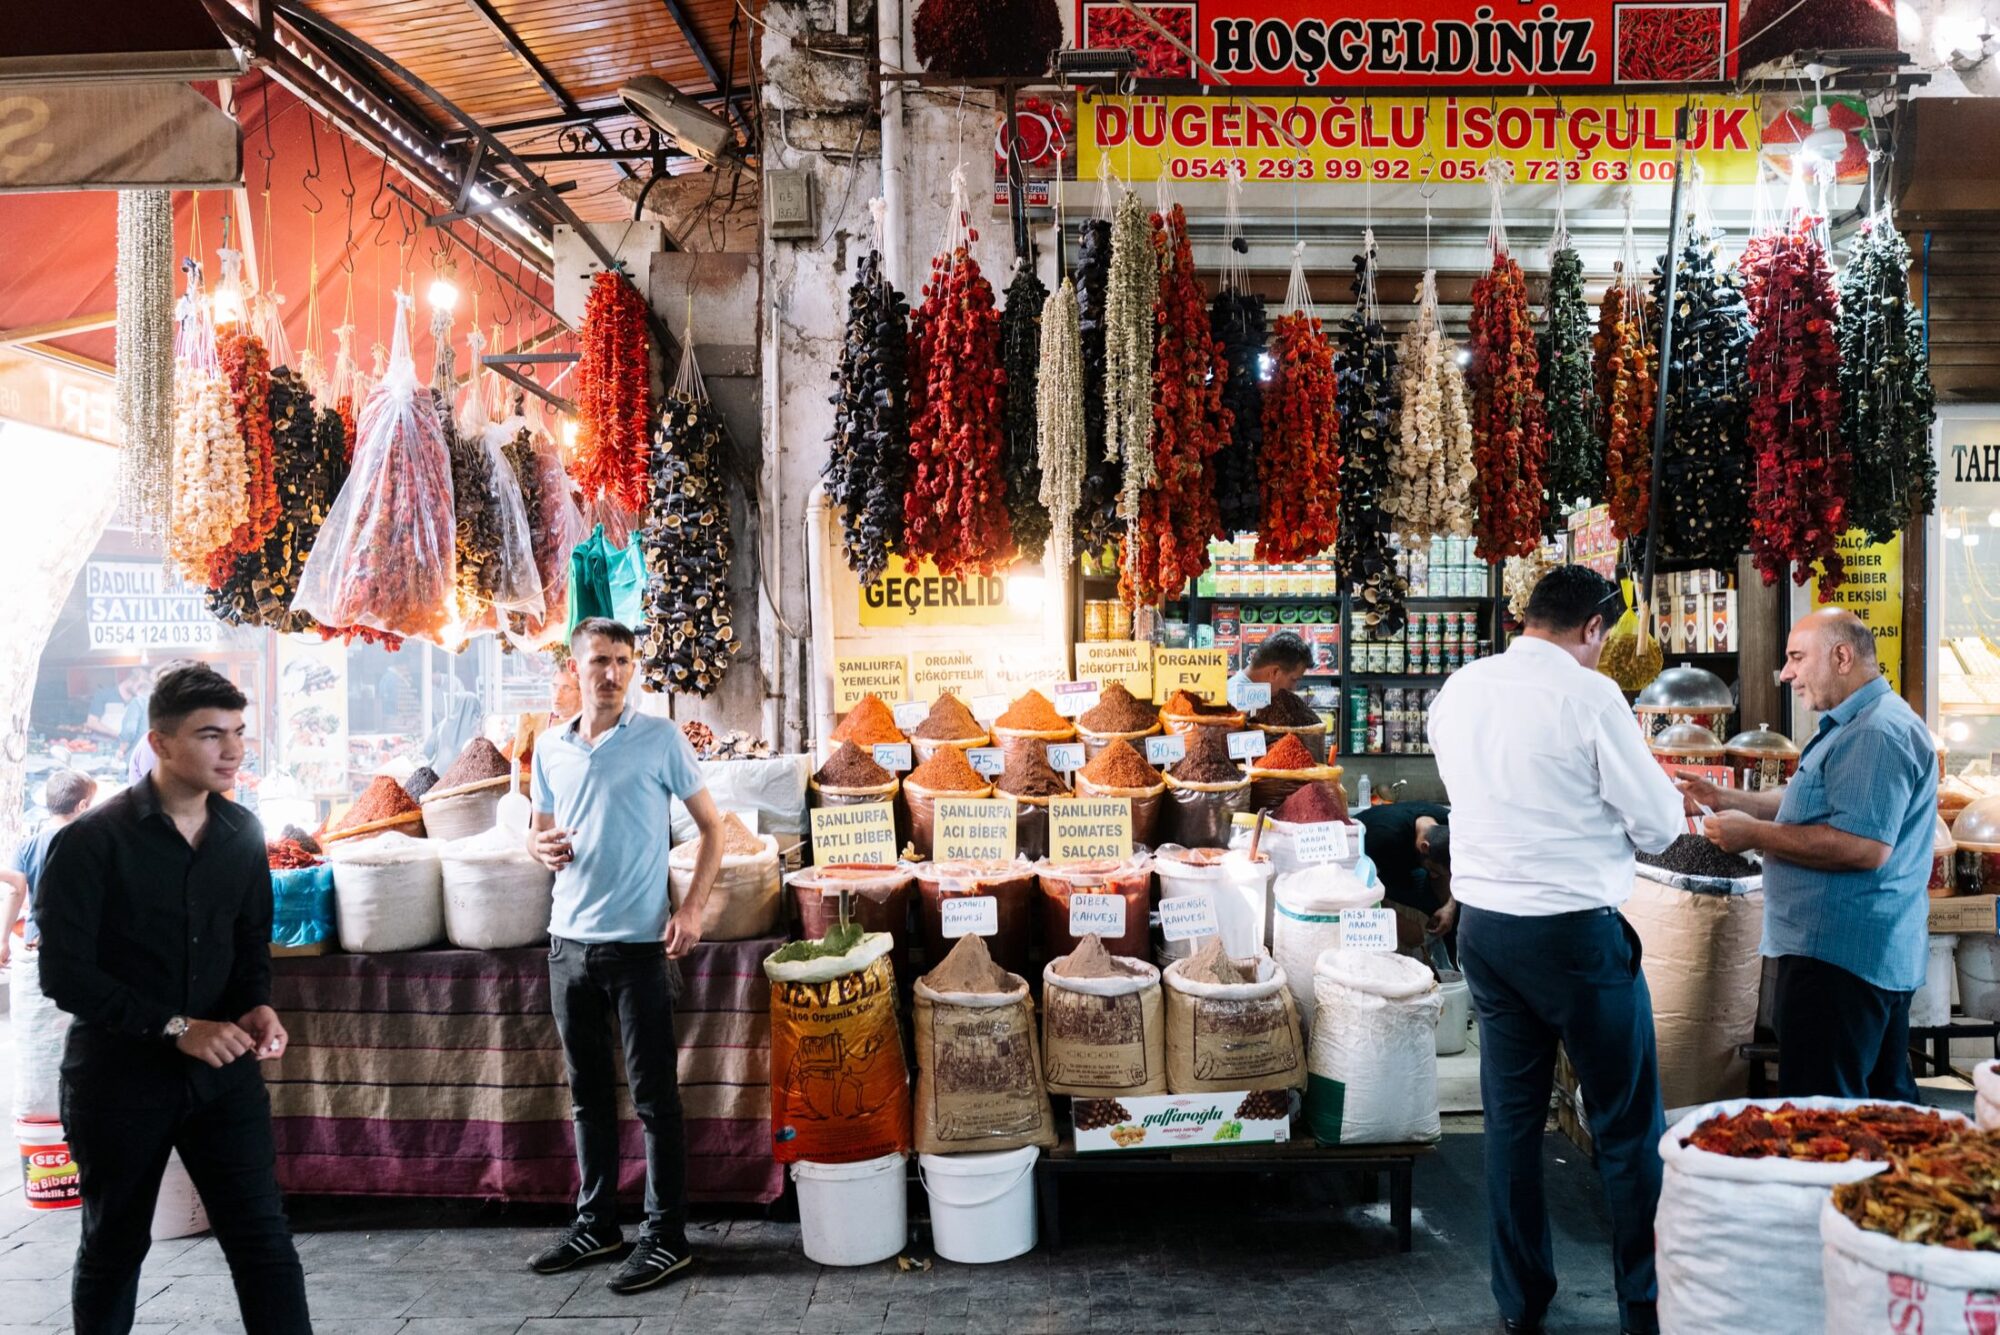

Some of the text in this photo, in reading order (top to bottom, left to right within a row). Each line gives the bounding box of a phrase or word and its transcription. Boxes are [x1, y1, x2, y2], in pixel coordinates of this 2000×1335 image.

[1212, 6, 1595, 85] HOŞGELDİNİZ
[1096, 96, 1750, 160] DÜGEROĞLU İSOTÇULUK
[1258, 159, 1314, 179] 293
[1325, 159, 1361, 179] 99
[1374, 160, 1409, 179] 92
[1526, 161, 1581, 181] 723
[1592, 161, 1628, 180] 63
[1639, 161, 1675, 181] 00
[1951, 444, 2000, 482] TAH
[1845, 555, 1882, 566] BİBER
[1819, 572, 1887, 584] KABİBER
[1828, 589, 1887, 604] AR EKŞİSİ
[141, 626, 168, 643] 124
[173, 626, 190, 643] 03
[194, 625, 212, 642] 33
[925, 652, 973, 666] ORGANİK
[1089, 646, 1137, 658] ORGANİK
[1158, 652, 1222, 666] ORGANİK
[839, 660, 903, 673] ŞANLIURFA
[842, 674, 900, 686] YEMEKLİK
[1179, 672, 1201, 684] EV
[845, 691, 860, 701] EV
[876, 750, 894, 765] 75
[970, 754, 992, 770] 75
[1052, 750, 1071, 767] 80
[816, 809, 888, 827] ŞANLIURFA
[940, 804, 1011, 820] ŞANLIURFA
[1053, 804, 1128, 820] ŞANLIURFA
[814, 829, 893, 848] TATLI BİBER
[943, 824, 1008, 839] ACI BİBER
[1059, 825, 1123, 838] DOMATES
[1062, 845, 1119, 860] SALÇASI
[1072, 910, 1118, 923] KAHVESİ
[812, 1010, 853, 1023] Organik
[1141, 1105, 1223, 1128] gaffaroğlu
[35, 1154, 66, 1167] SEÇ
